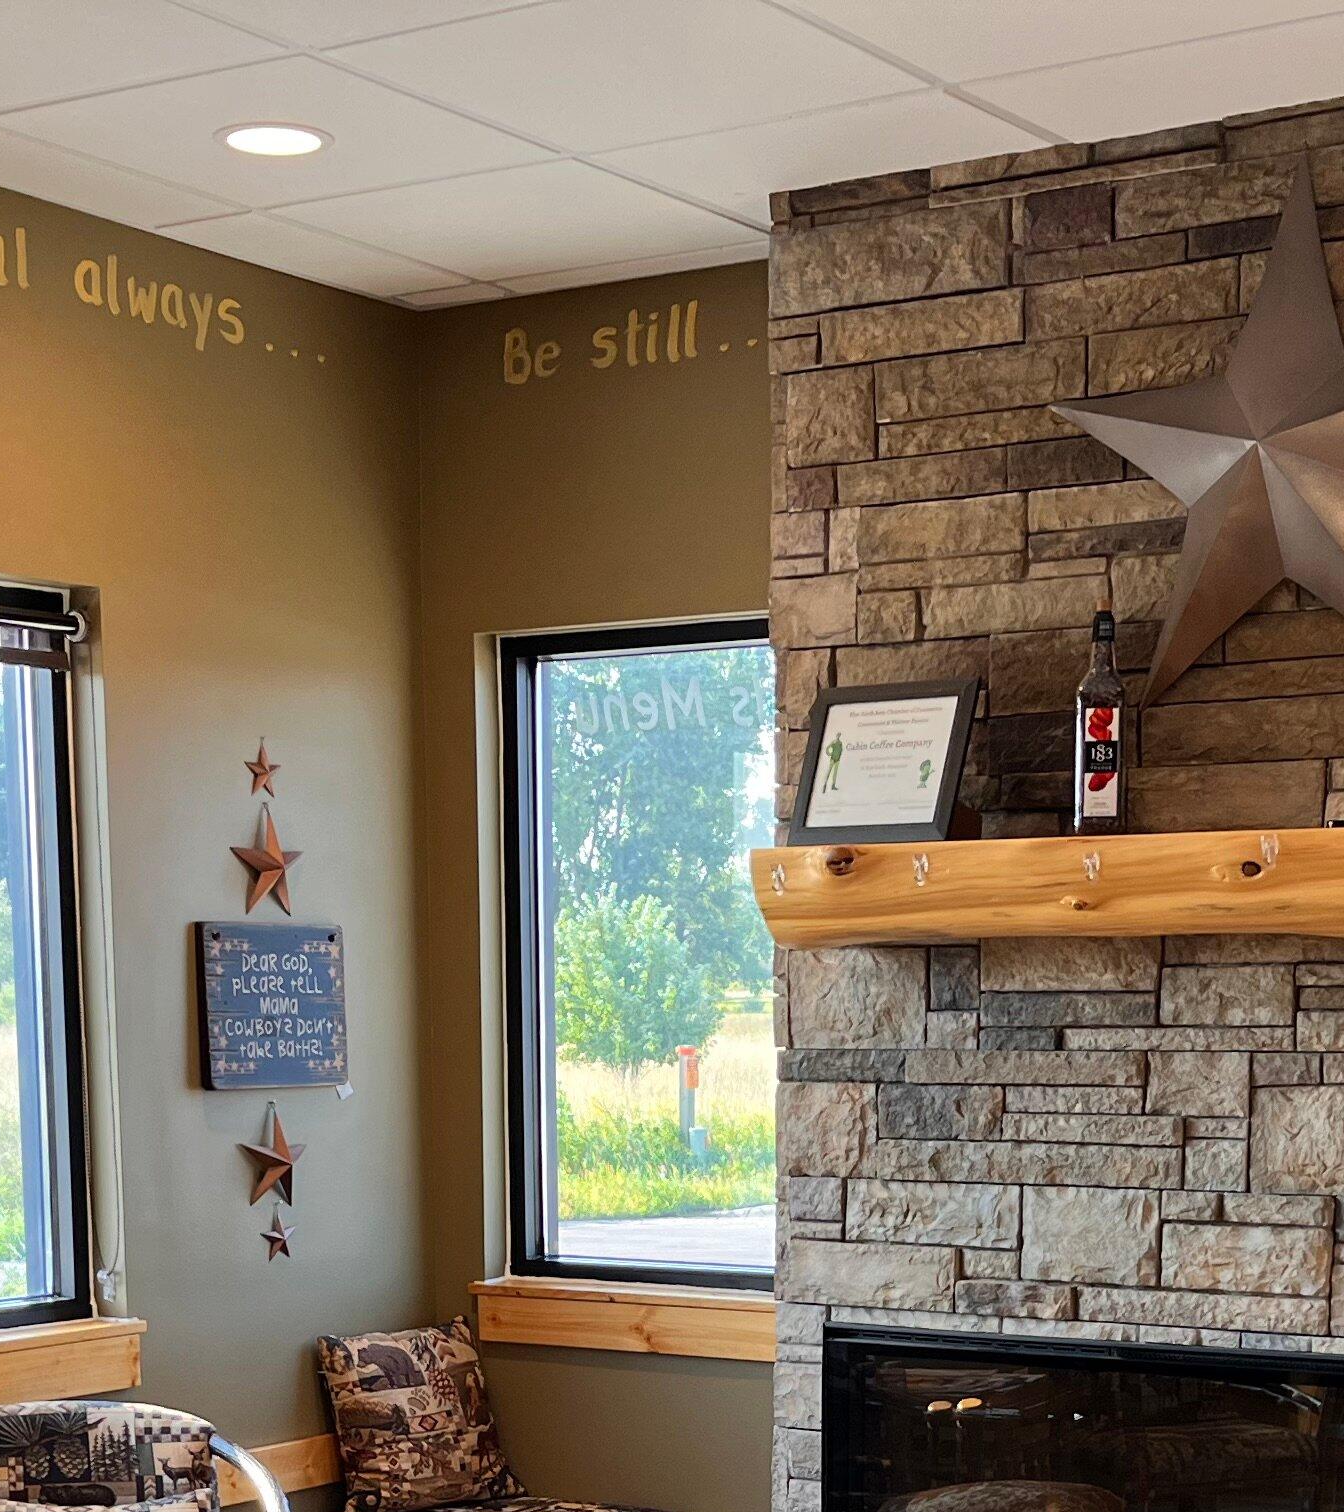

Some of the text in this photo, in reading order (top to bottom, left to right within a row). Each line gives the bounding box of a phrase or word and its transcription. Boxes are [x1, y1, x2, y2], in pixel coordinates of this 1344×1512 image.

[504, 327, 562, 385] Be
[869, 739, 894, 750] Coffee
[895, 738, 933, 750] Company
